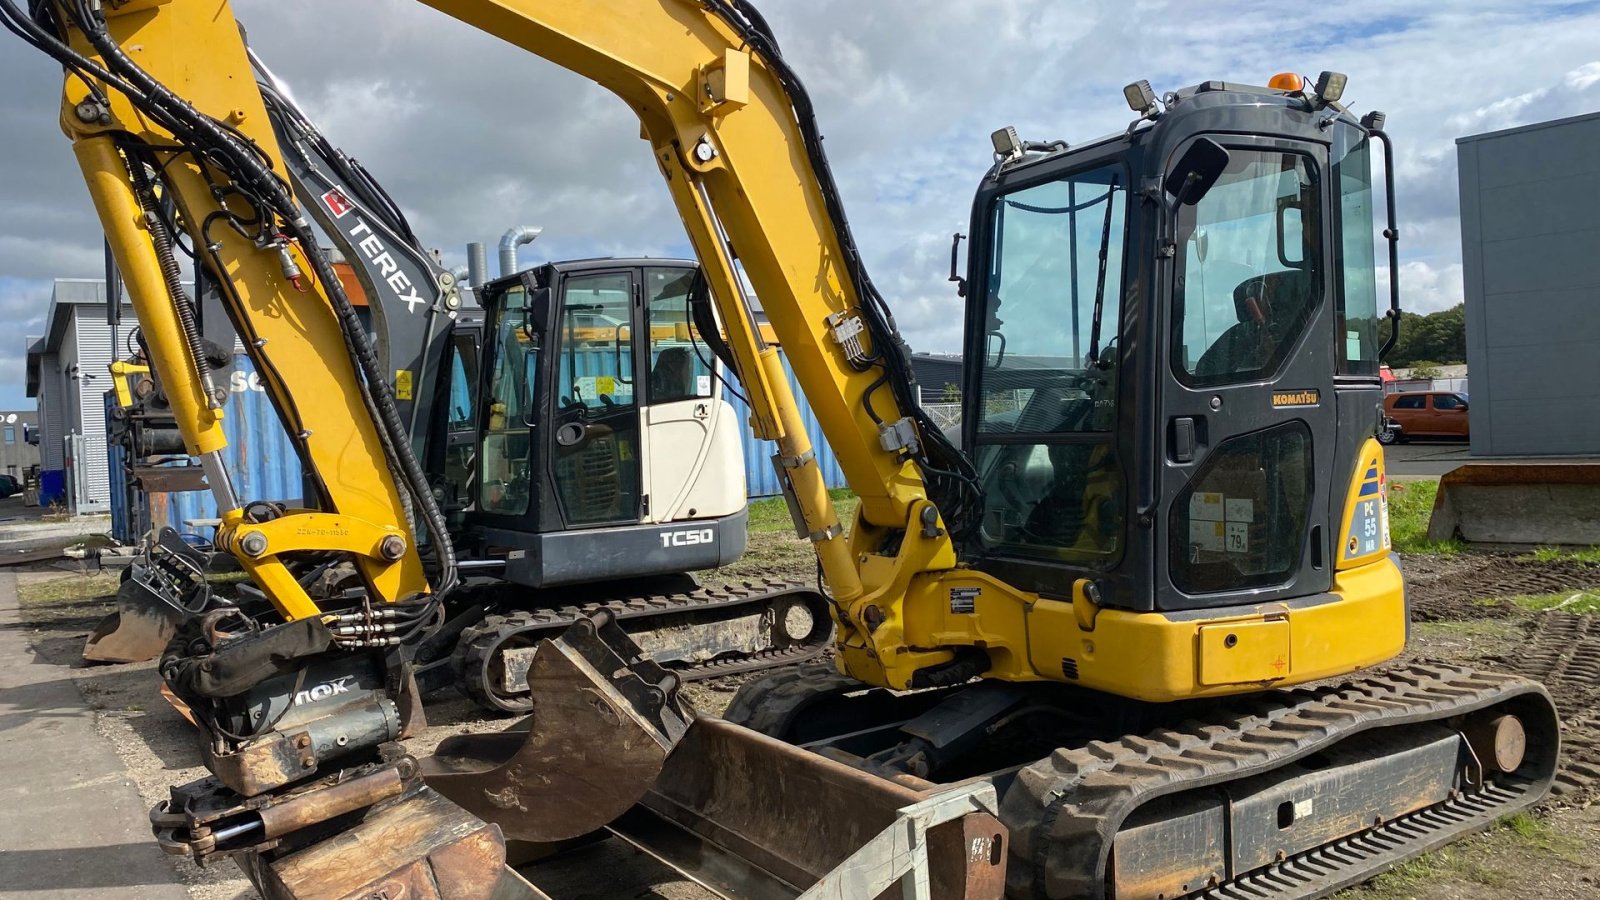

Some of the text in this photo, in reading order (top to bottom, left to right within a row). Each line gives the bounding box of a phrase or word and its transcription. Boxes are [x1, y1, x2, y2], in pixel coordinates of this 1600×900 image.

[349, 216, 426, 314] TEREX
[1273, 391, 1317, 405] KOMATSU
[1364, 501, 1374, 516] PC
[1364, 518, 1376, 537] 55
[660, 528, 713, 547] TC50
[1230, 534, 1242, 549] 79
[1365, 540, 1375, 553] MR
